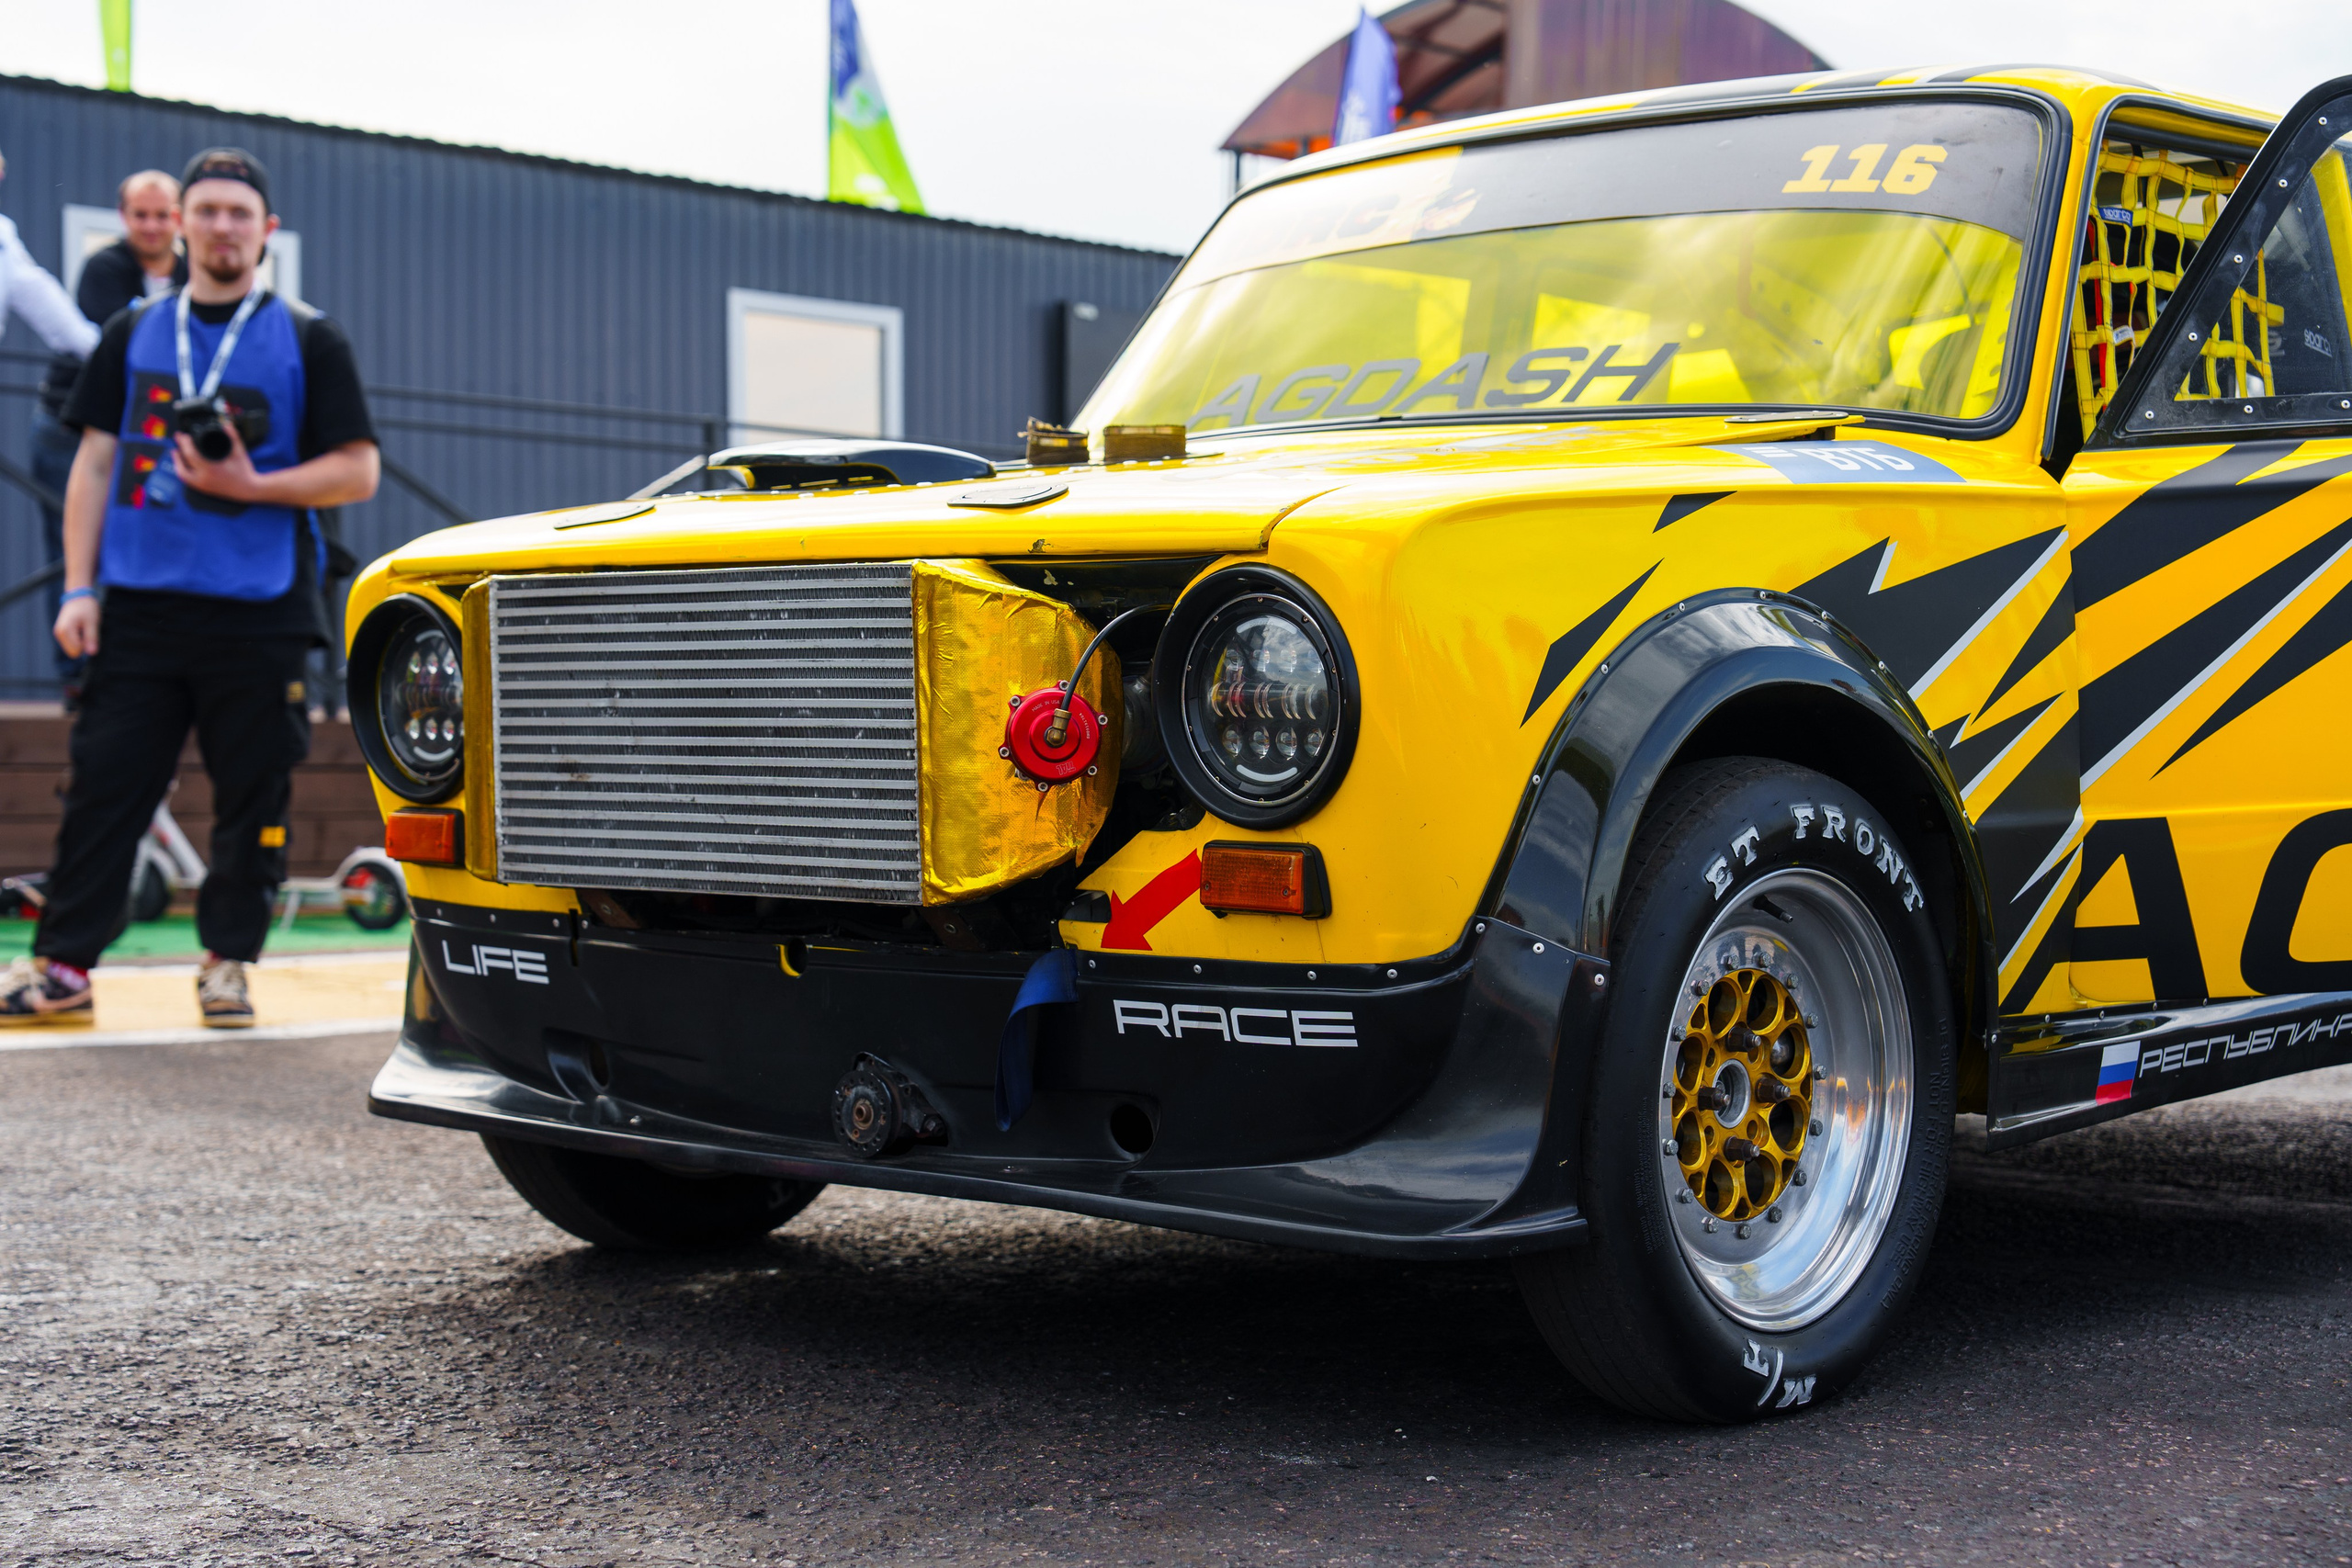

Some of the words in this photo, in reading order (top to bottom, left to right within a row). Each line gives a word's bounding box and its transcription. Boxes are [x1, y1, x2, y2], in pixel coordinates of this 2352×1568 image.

[1781, 143, 1949, 195] 116
[1187, 343, 1680, 428] AGDASH
[1703, 823, 1760, 901] ET
[1791, 804, 1925, 913] FRONT
[442, 939, 550, 985] LIFE
[1113, 998, 1359, 1047] RACE
[1928, 1072, 1941, 1108] NOT
[1925, 1117, 1939, 1154] FOR
